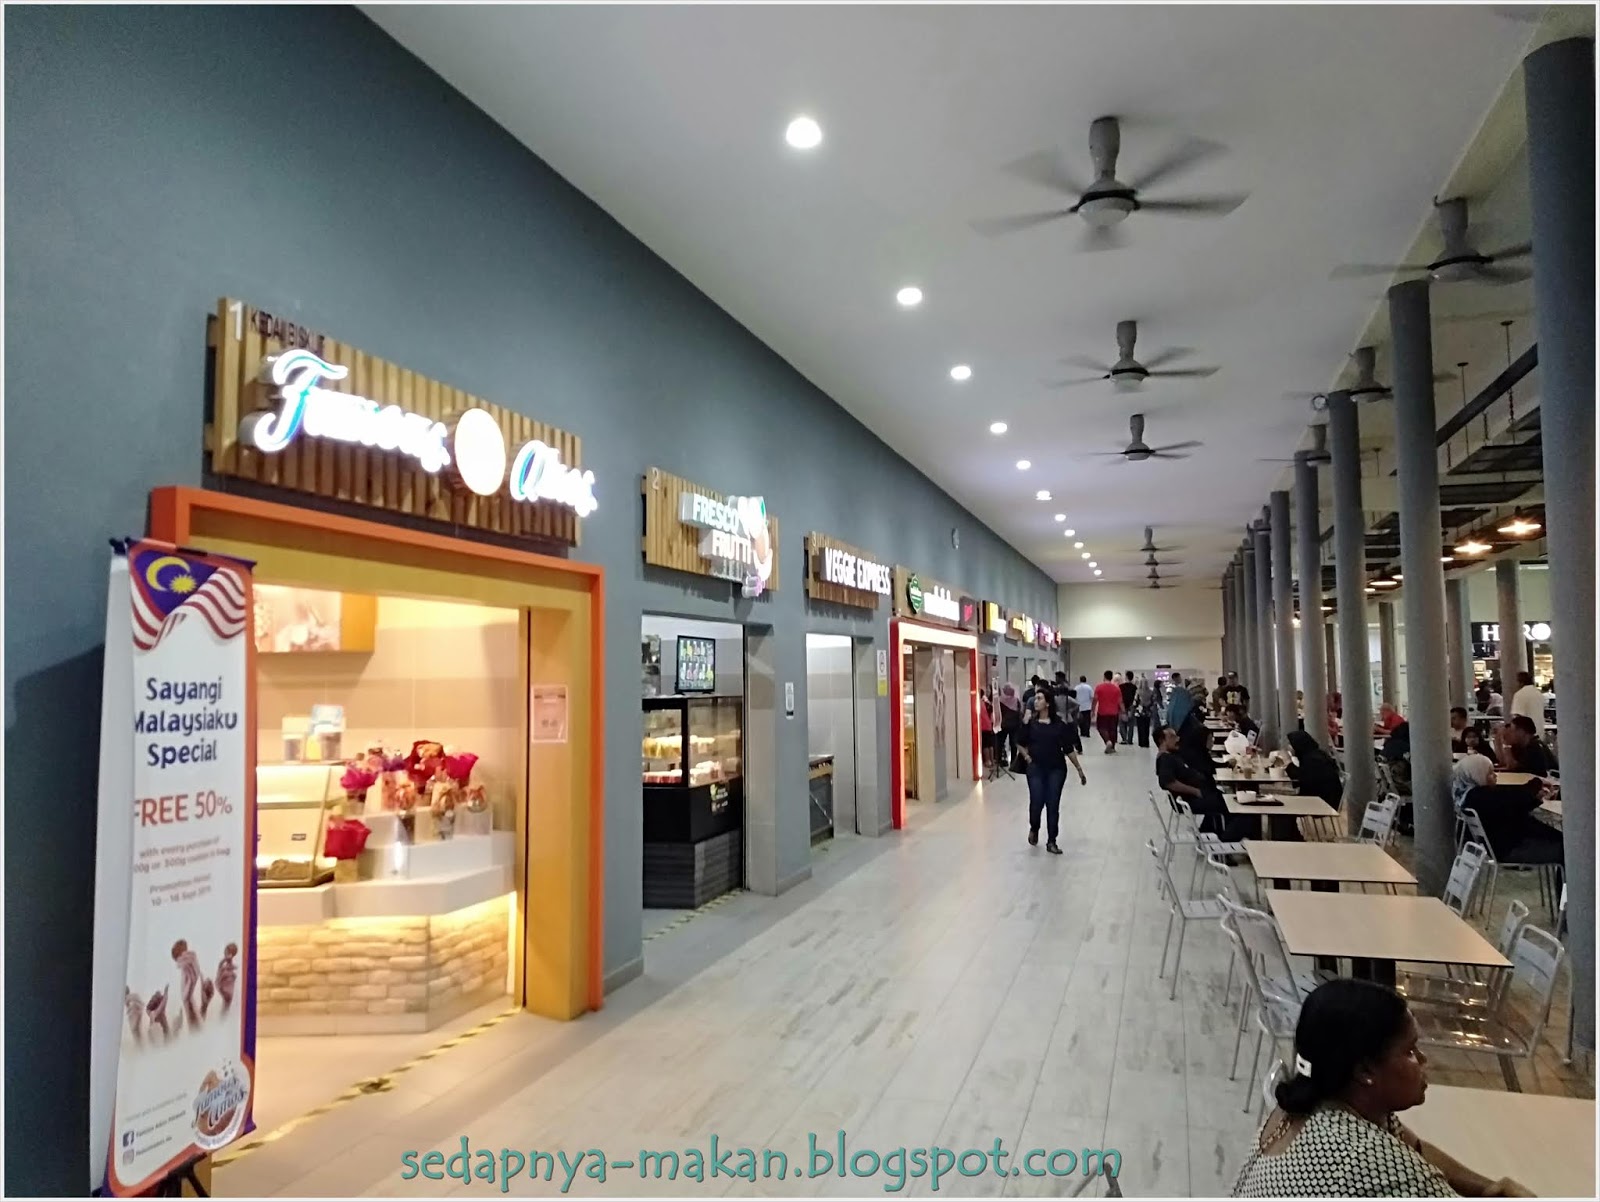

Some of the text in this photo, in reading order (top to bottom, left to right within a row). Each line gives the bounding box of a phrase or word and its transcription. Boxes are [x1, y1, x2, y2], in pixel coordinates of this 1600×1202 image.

[229, 301, 243, 341] 1
[651, 467, 660, 490] 2
[693, 493, 740, 535] FRESCO
[825, 546, 856, 588] VEGGIE
[857, 558, 891, 596] EXPRESS
[146, 676, 222, 704] Sayangi
[147, 739, 218, 769] Special
[195, 790, 233, 820] 50%
